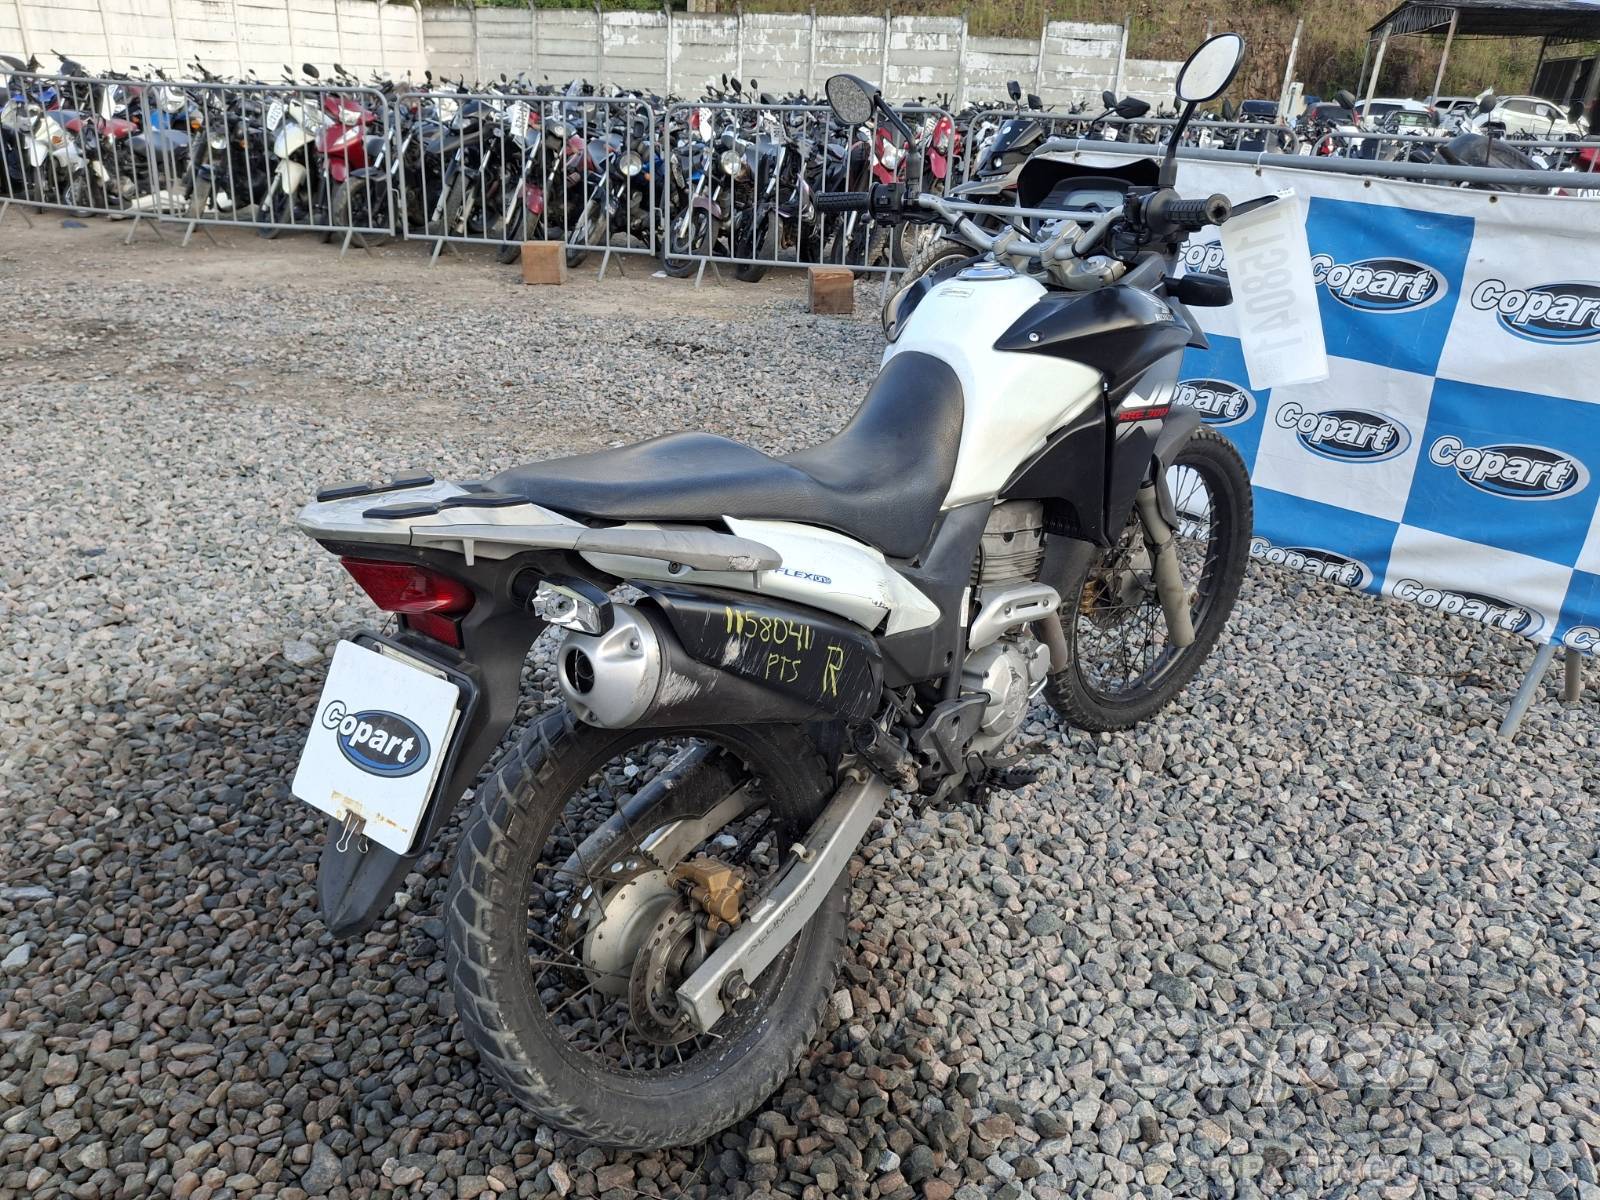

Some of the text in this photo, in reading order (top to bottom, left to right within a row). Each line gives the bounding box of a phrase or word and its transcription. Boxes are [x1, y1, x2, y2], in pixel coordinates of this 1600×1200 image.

[1311, 254, 1432, 302] Copart
[1471, 279, 1600, 328] Copar
[1275, 401, 1395, 452] Copart
[1429, 435, 1572, 491] Copart
[1249, 536, 1360, 588] Copart
[725, 606, 810, 651] 1158041
[1392, 578, 1526, 633] Copart
[765, 653, 801, 683] PTS
[822, 646, 844, 697] R
[322, 700, 415, 763] Copart
